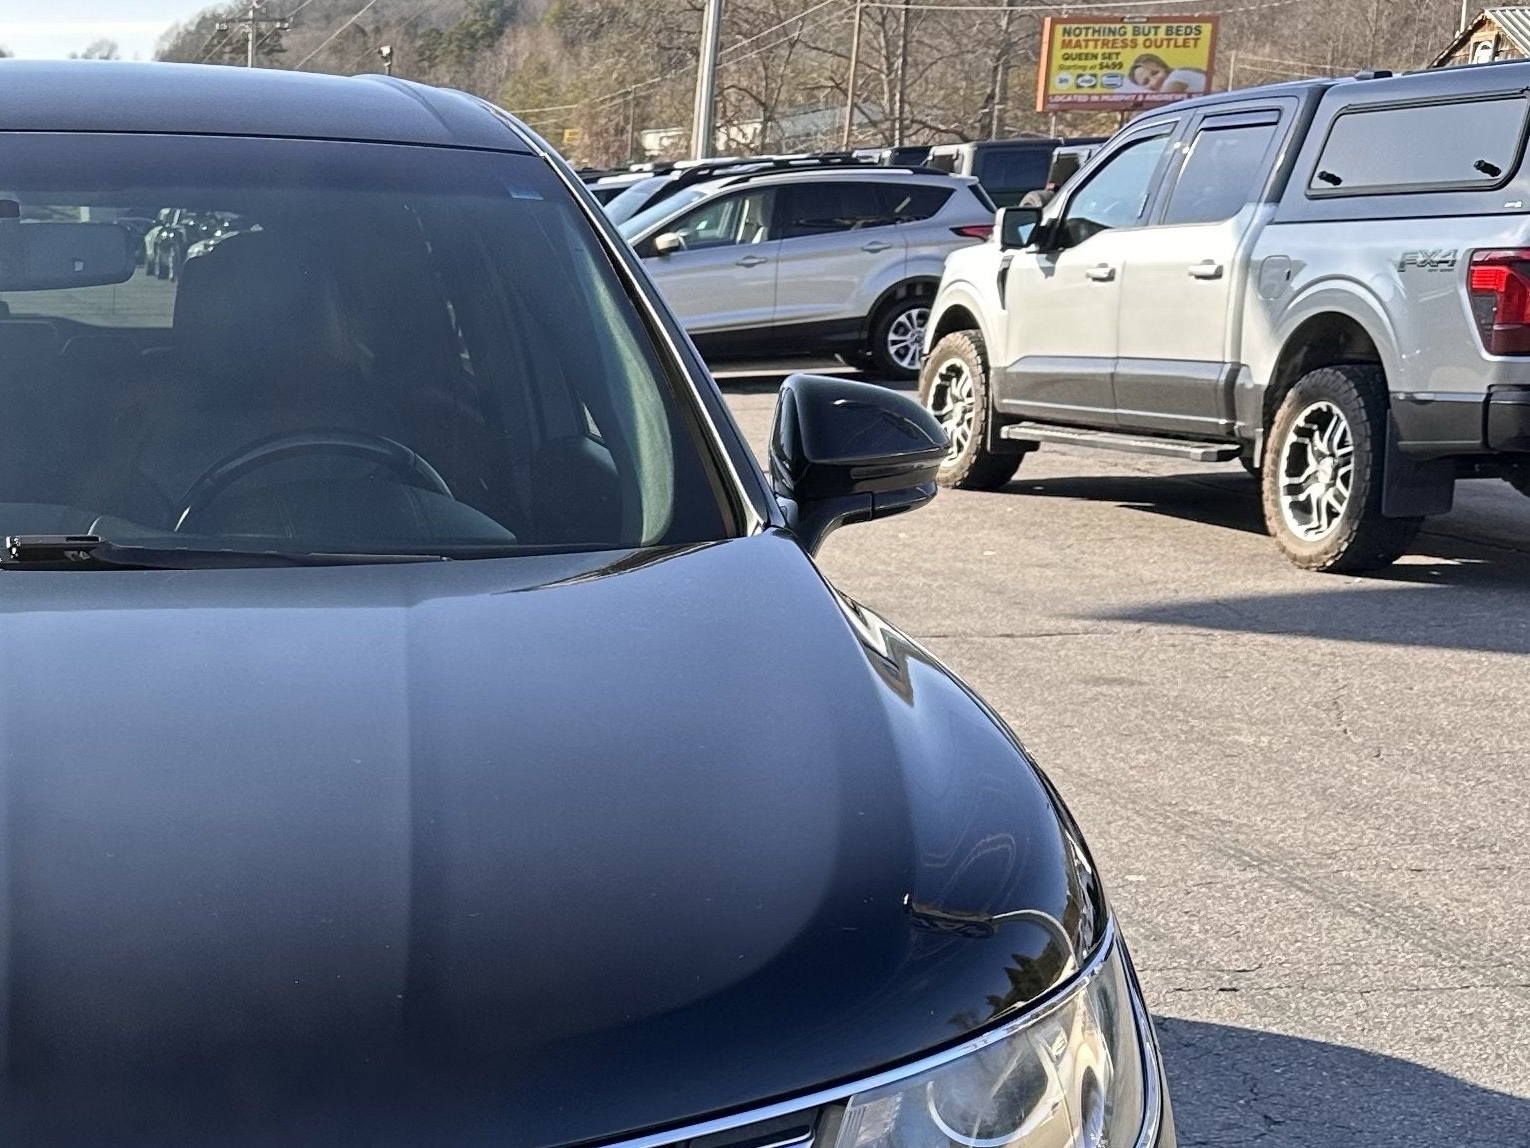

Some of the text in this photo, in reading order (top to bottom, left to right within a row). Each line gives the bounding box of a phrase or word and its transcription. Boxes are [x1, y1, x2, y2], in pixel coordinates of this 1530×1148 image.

[1062, 25, 1202, 37] NOTHING BUT BEDS
[1061, 37, 1201, 49] MATTRESS OUTLET
[1062, 52, 1121, 61] QUEEN SET
[1099, 62, 1124, 70] $499
[1397, 249, 1458, 273] FX4
